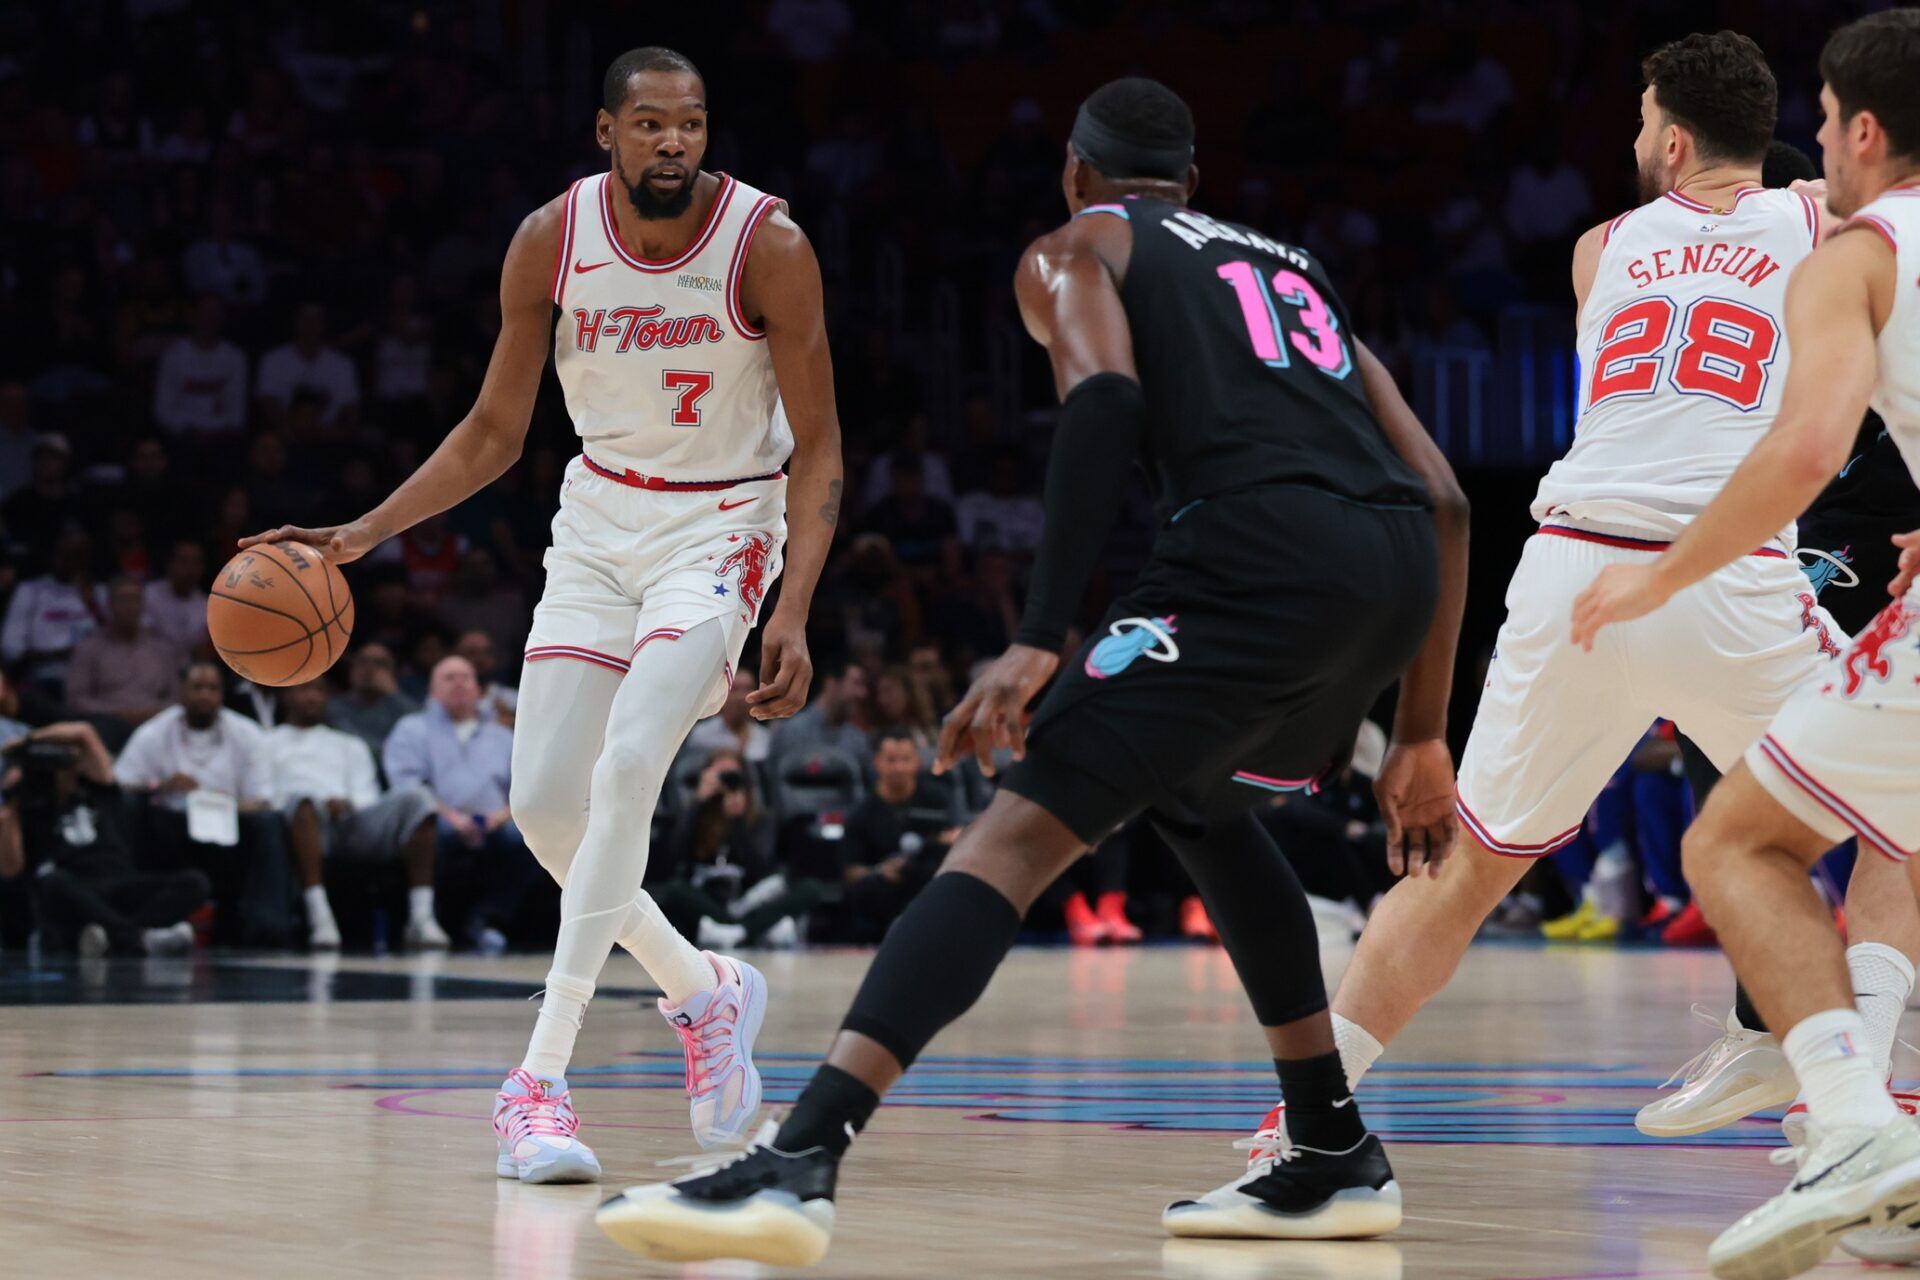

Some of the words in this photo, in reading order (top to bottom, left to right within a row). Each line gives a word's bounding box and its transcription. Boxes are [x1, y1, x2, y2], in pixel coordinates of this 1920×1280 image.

[676, 279, 722, 292] HERMANN
[677, 273, 722, 287] MEMORIAL
[1627, 243, 1780, 288] SENGUN
[573, 304, 725, 354] H-Town
[1216, 261, 1352, 380] 13
[1583, 295, 1781, 413] 28
[661, 368, 714, 427] 7
